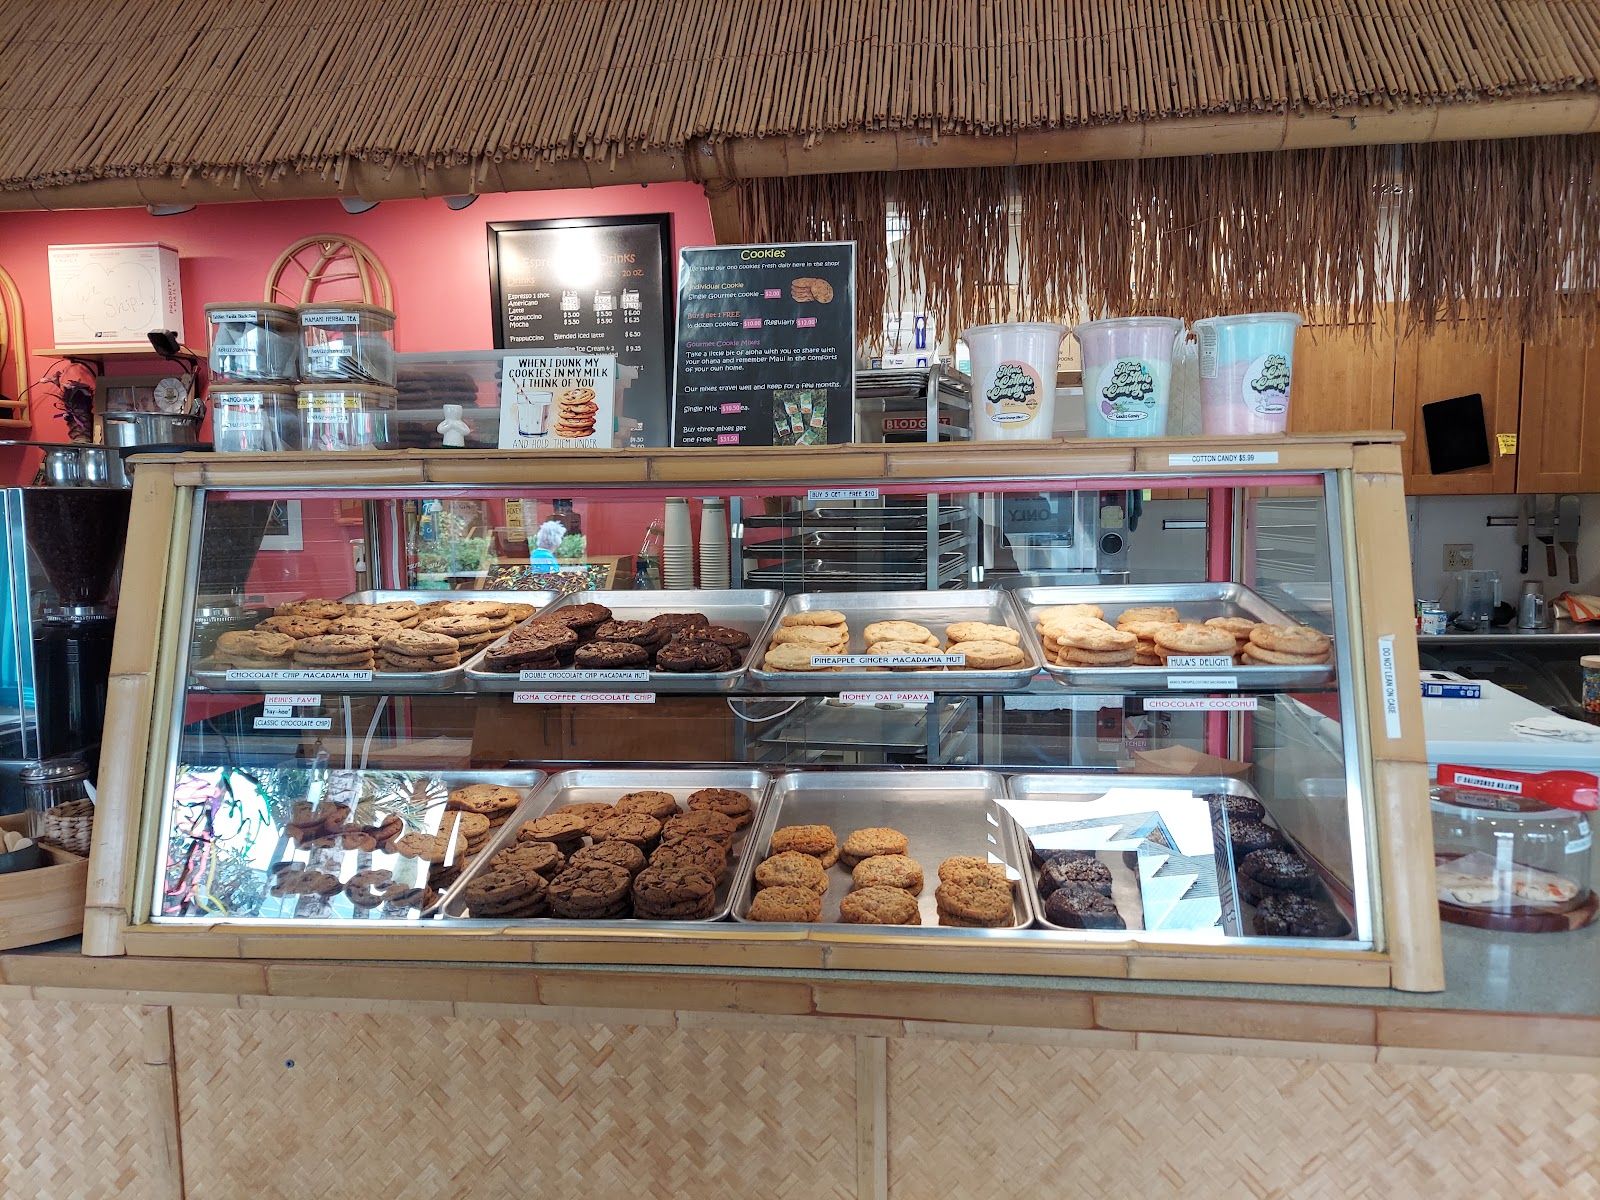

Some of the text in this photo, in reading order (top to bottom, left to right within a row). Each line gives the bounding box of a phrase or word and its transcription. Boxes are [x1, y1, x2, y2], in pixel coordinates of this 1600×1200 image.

[740, 249, 786, 261] Cookies
[721, 282, 744, 290] Cookie
[708, 292, 737, 300] Gourmet
[508, 314, 543, 322] Cappuccino
[509, 321, 530, 329] Mocha
[554, 332, 577, 341] Blended
[686, 351, 702, 359] Take
[795, 354, 806, 362] the
[519, 358, 600, 368] WHEN DUNK MY
[725, 364, 744, 372] home.
[508, 368, 608, 378] COOKIES IN MY MILK
[527, 378, 594, 388] THINK OF YOU
[994, 372, 1035, 388] Cotton
[1111, 371, 1153, 387] Cotton
[986, 384, 1026, 403] Candy
[1102, 383, 1144, 401] Candy
[683, 406, 703, 414] Single
[682, 426, 696, 434] Buy
[512, 438, 598, 449] AND HOLD THEM UNDER
[1217, 454, 1237, 462] CANDY
[1238, 454, 1255, 462] $5.99
[1170, 658, 1230, 667] HULA'S DELIGHT
[1382, 647, 1396, 714] DO NOT LEAN ON CASE
[255, 719, 279, 727] (CLASSIC
[1496, 782, 1519, 791] GLUTEN
